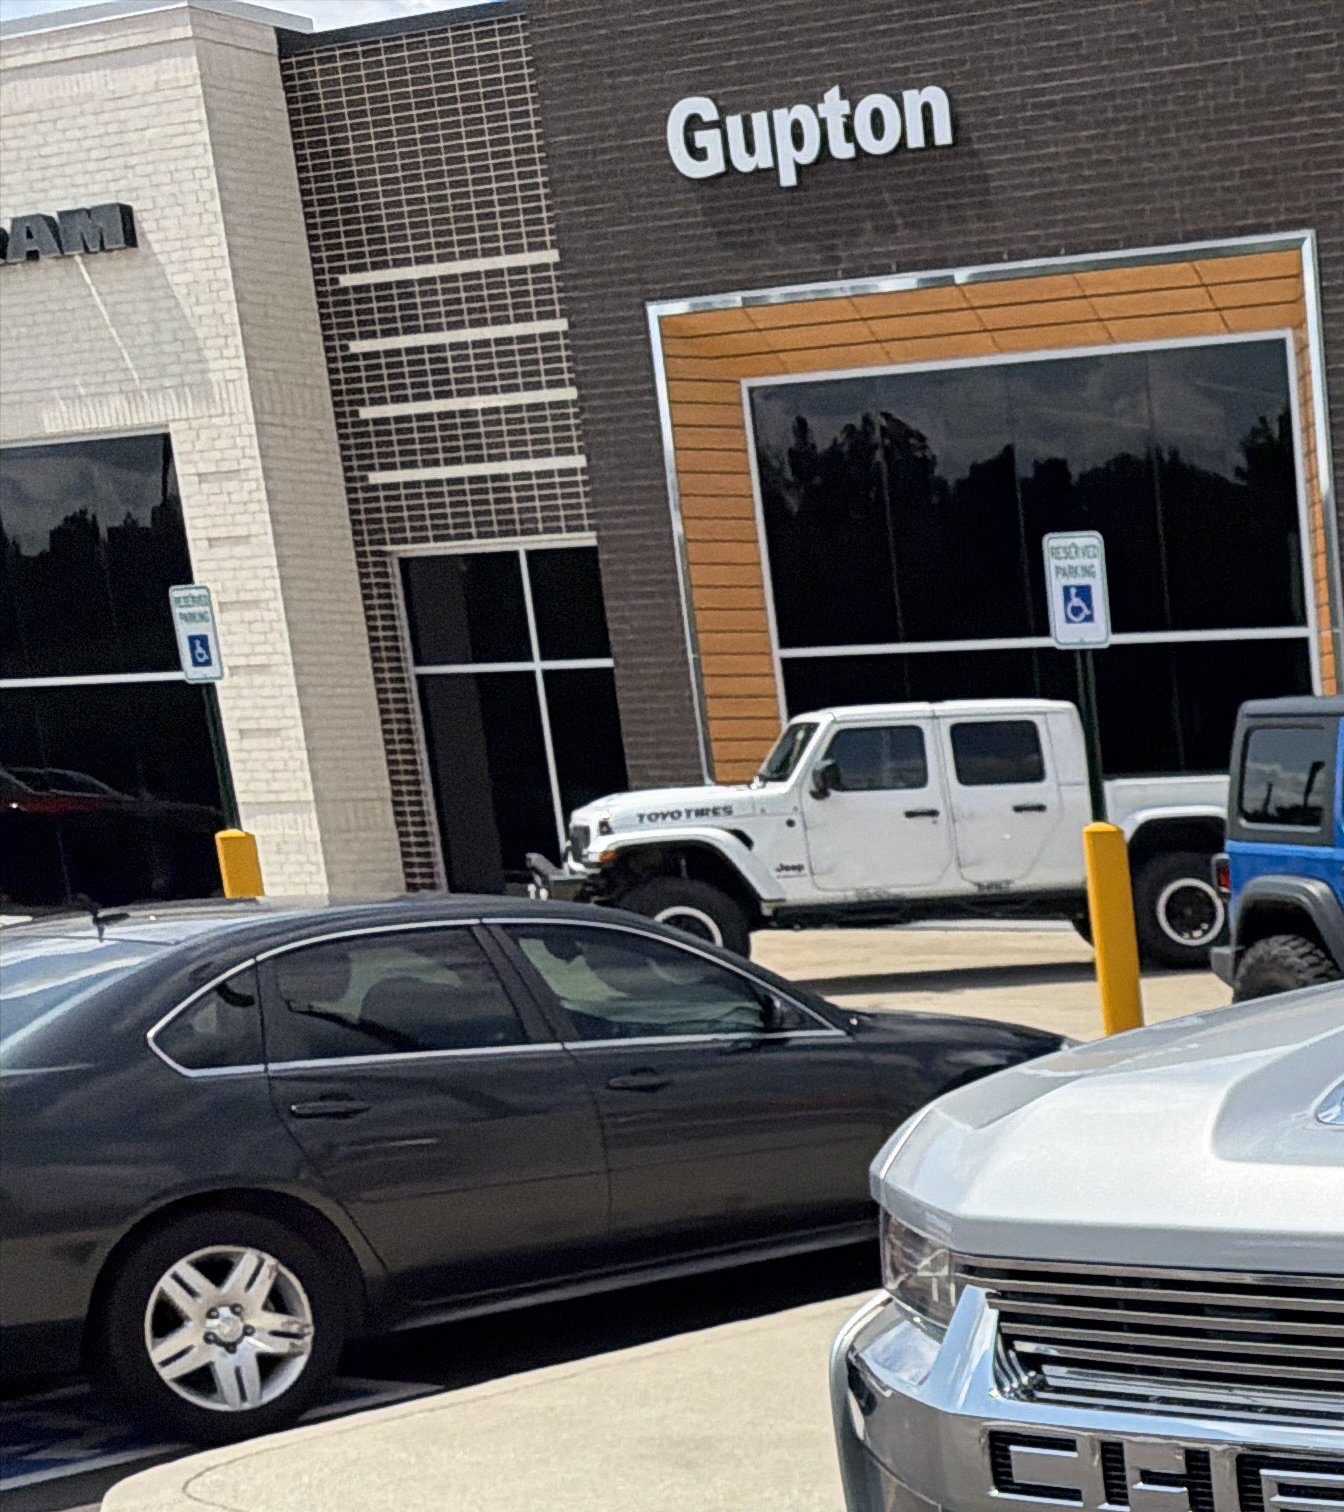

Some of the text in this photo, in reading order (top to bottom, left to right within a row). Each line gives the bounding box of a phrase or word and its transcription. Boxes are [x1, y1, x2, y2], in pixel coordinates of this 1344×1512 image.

[665, 84, 953, 187] Gupton
[0, 202, 138, 265] AM
[1050, 543, 1099, 560] RESERVED
[1055, 564, 1097, 579] PARKING
[637, 804, 733, 824] TOYO TIRES
